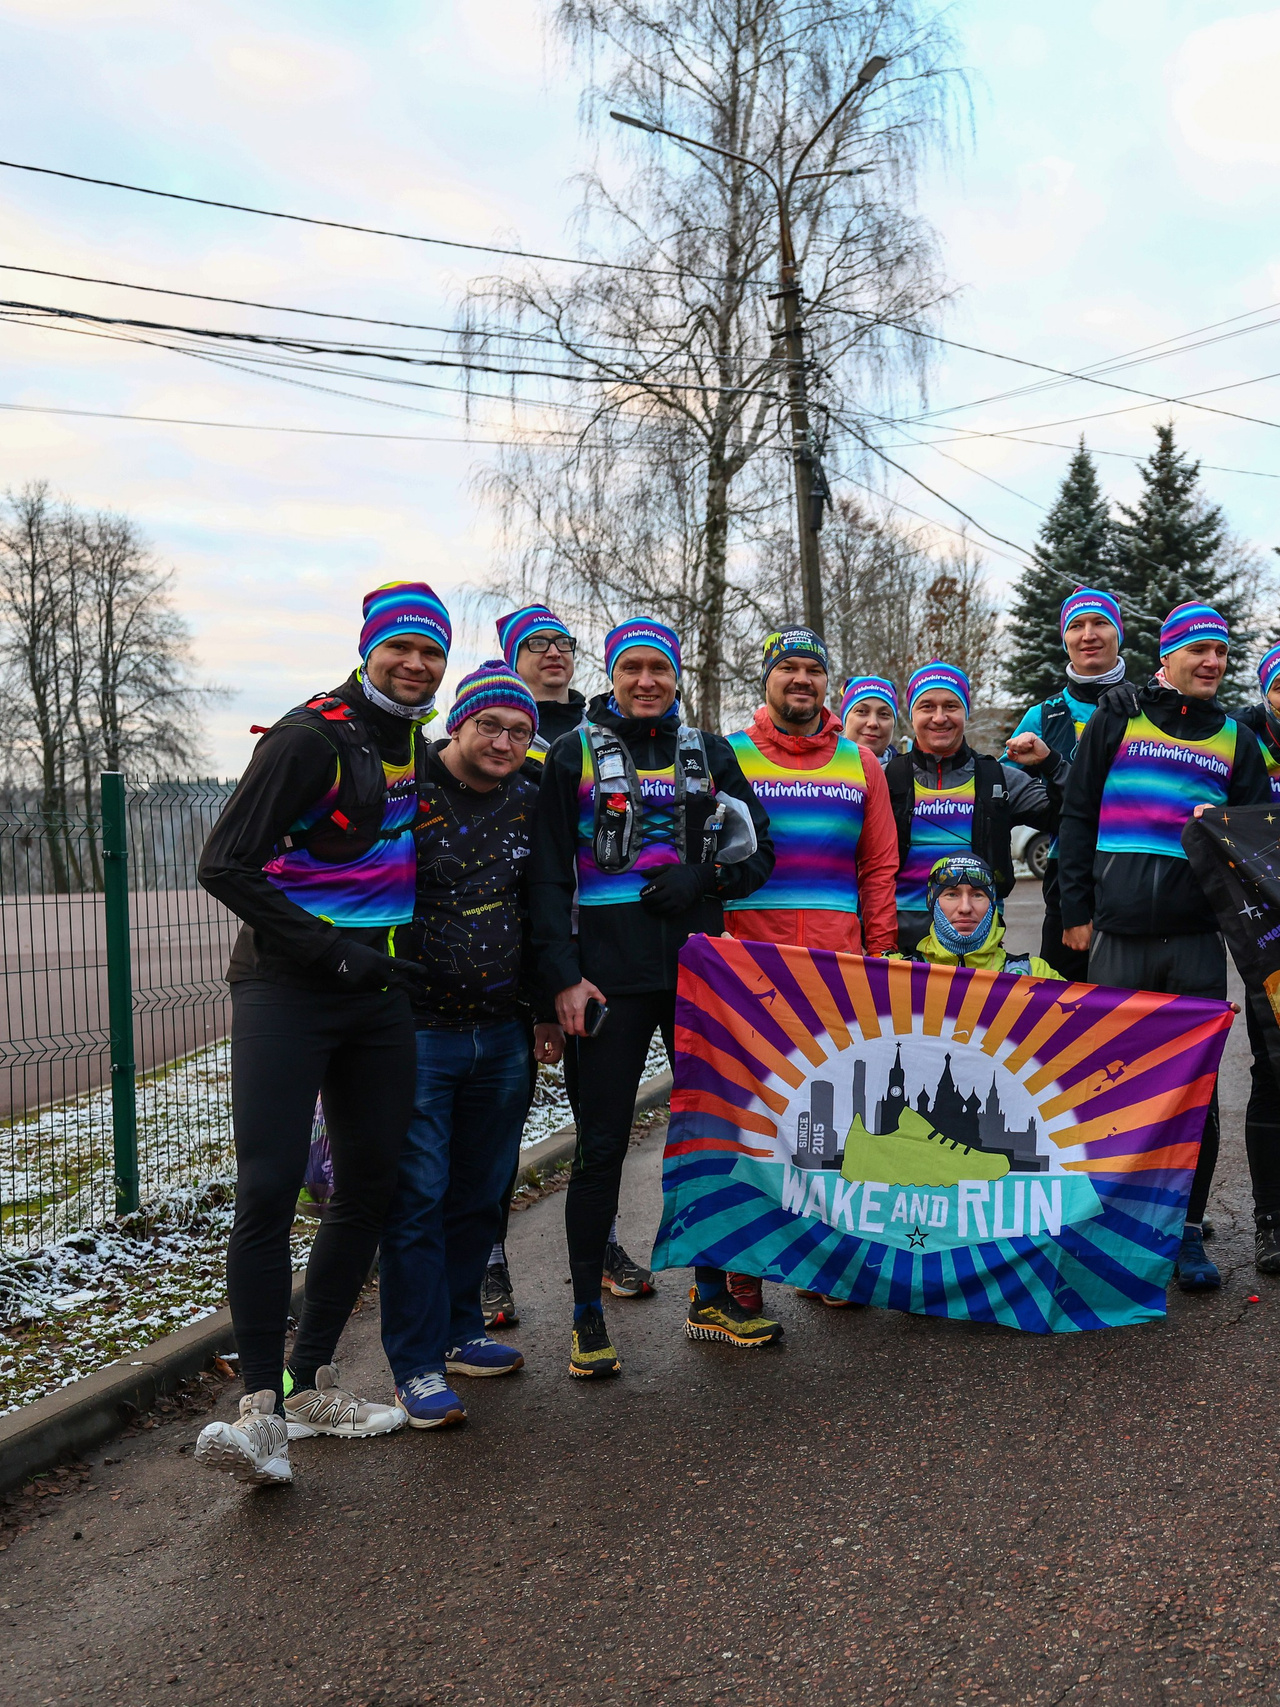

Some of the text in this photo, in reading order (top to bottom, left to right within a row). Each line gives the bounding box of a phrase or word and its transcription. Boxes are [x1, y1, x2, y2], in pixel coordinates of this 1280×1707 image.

[1127, 741, 1229, 777] #khimkirunbar
[798, 1117, 809, 1148] SINCE
[812, 1123, 825, 1155] 2015
[781, 1163, 1062, 1238] WAKE AND RUN
